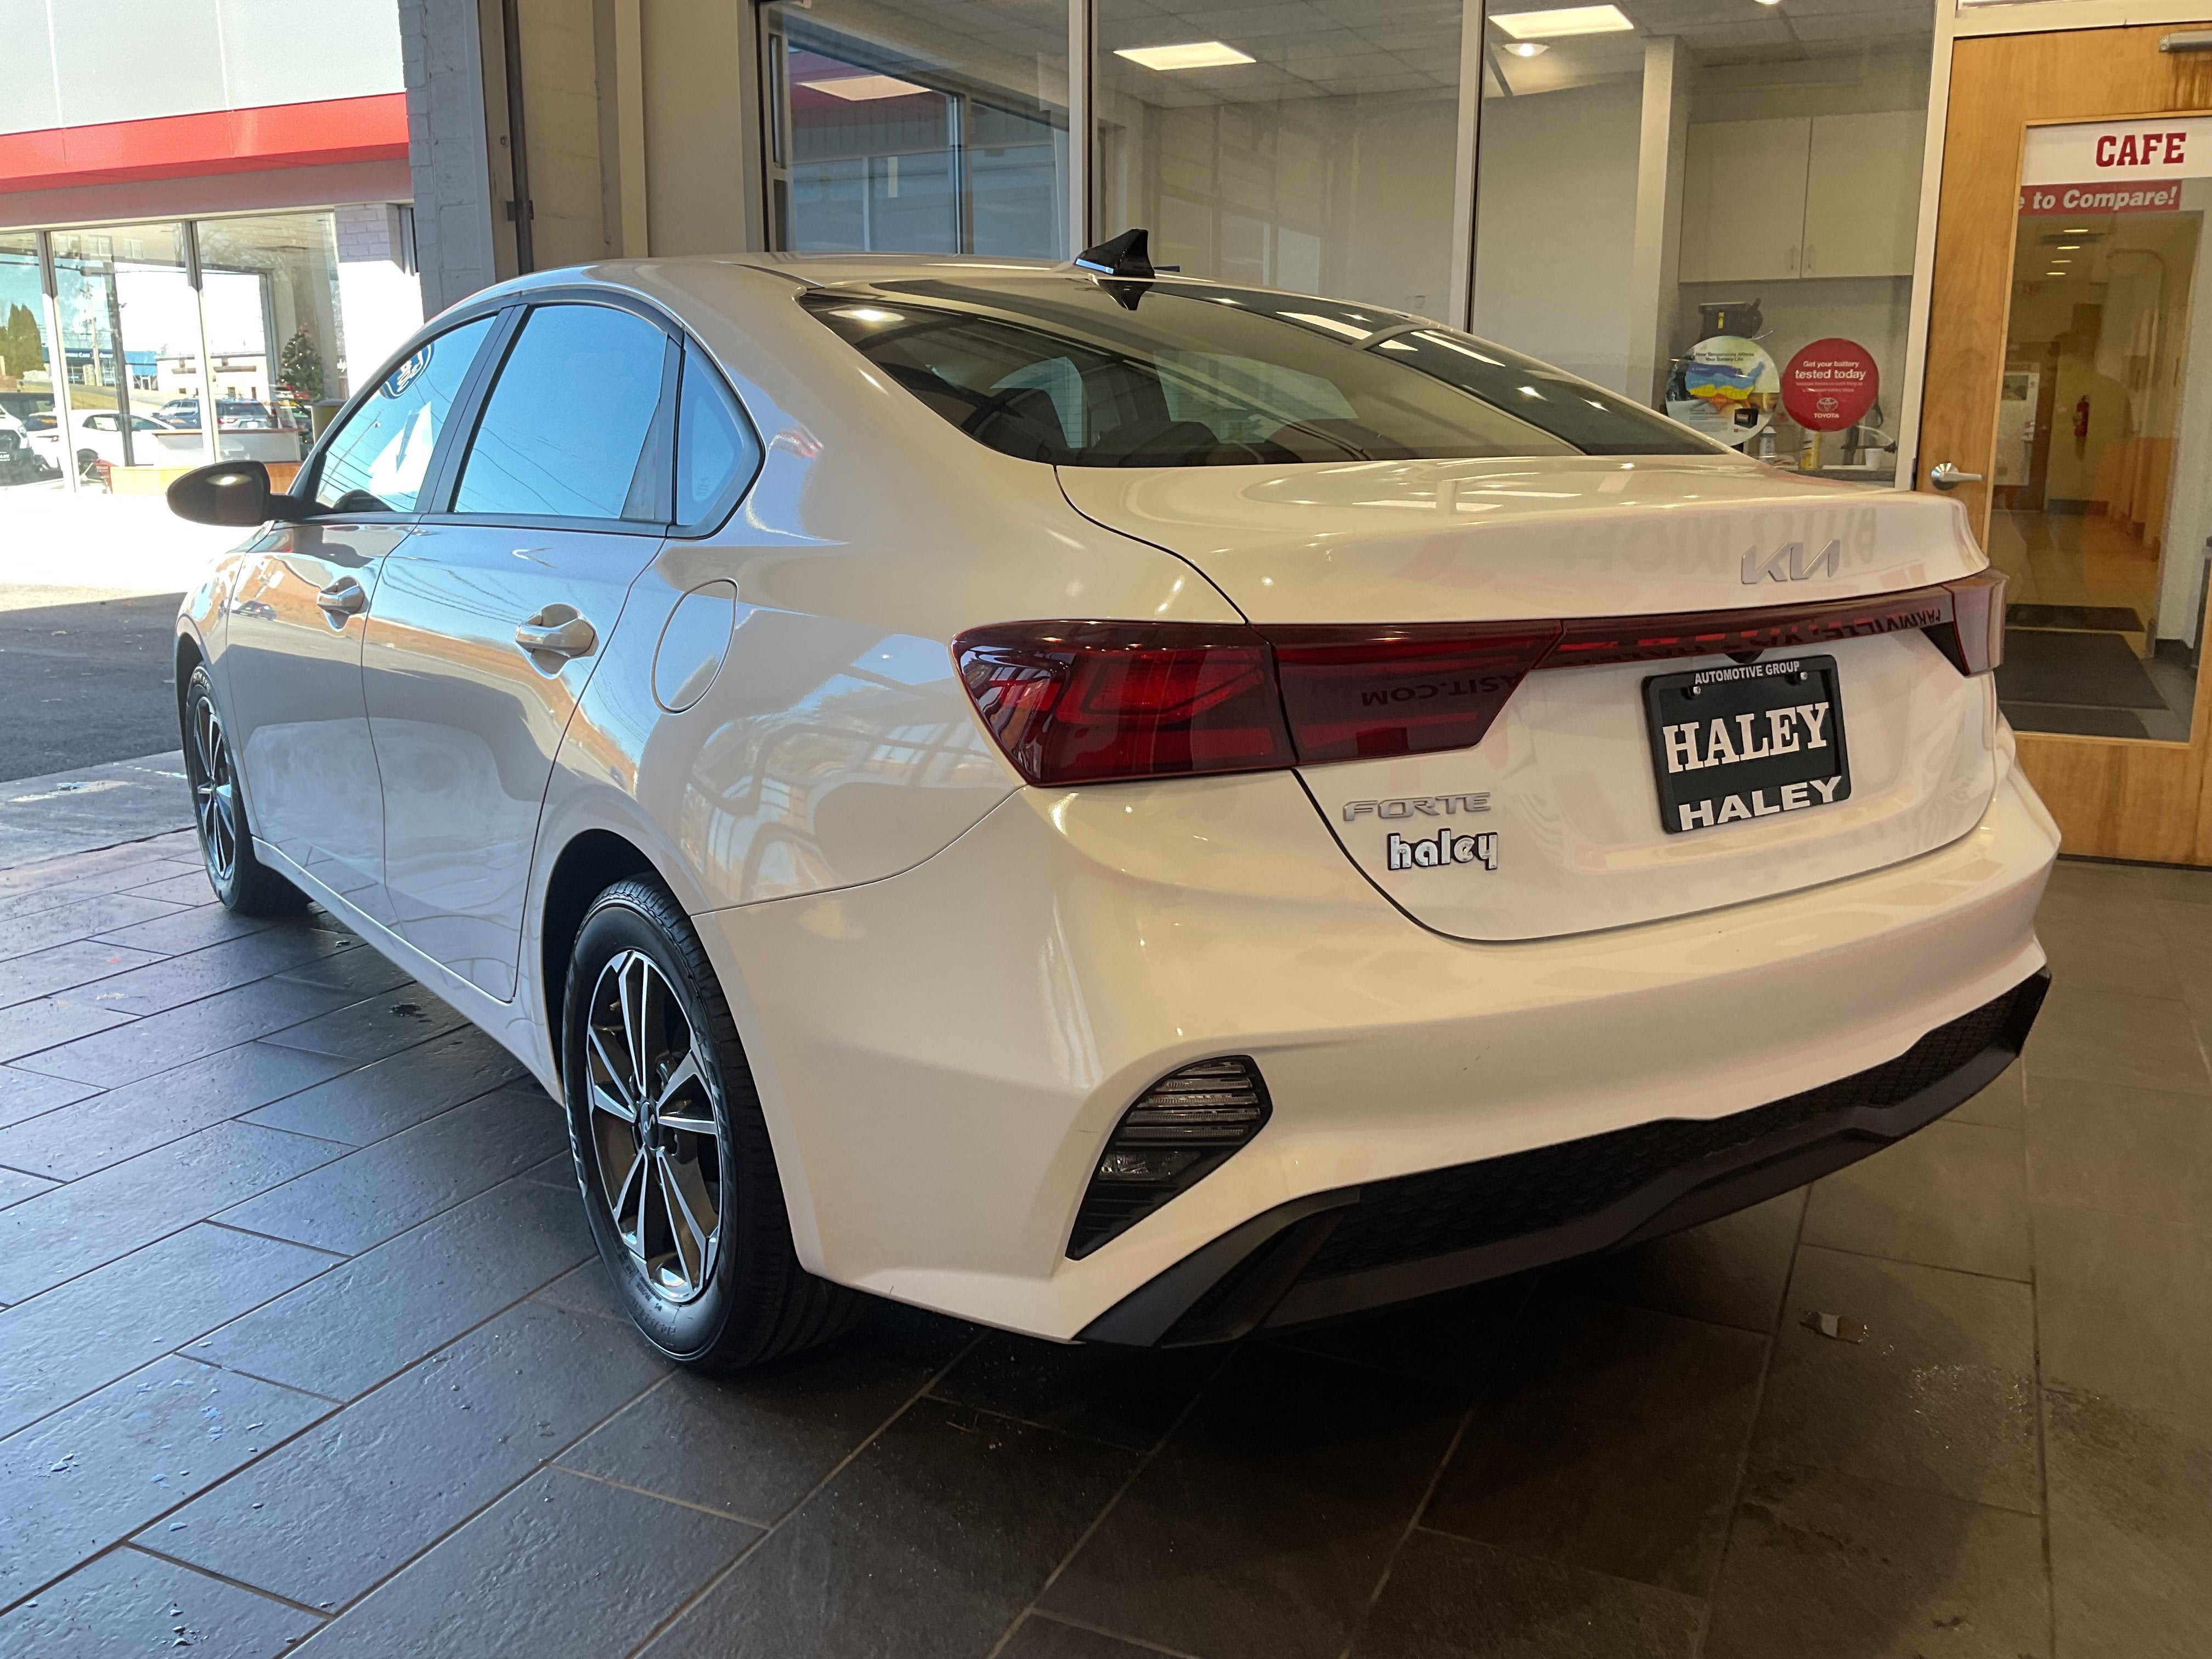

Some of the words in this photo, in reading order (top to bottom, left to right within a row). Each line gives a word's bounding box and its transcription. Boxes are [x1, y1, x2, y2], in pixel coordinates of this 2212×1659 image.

[2096, 132, 2186, 167] CAFE
[2033, 192, 2056, 209] to
[2063, 186, 2177, 211] Compare!
[1795, 369, 1831, 379] tested
[1834, 369, 1866, 381] today
[1741, 539, 1841, 584] KIA
[1695, 665, 1763, 684] AUTOMOTIVE
[1765, 661, 1799, 675] GROUP
[1662, 702, 1829, 774] HALEY
[1343, 792, 1491, 821] FORTE
[1678, 776, 1842, 831] HALEY
[1388, 828, 1498, 871] haley
